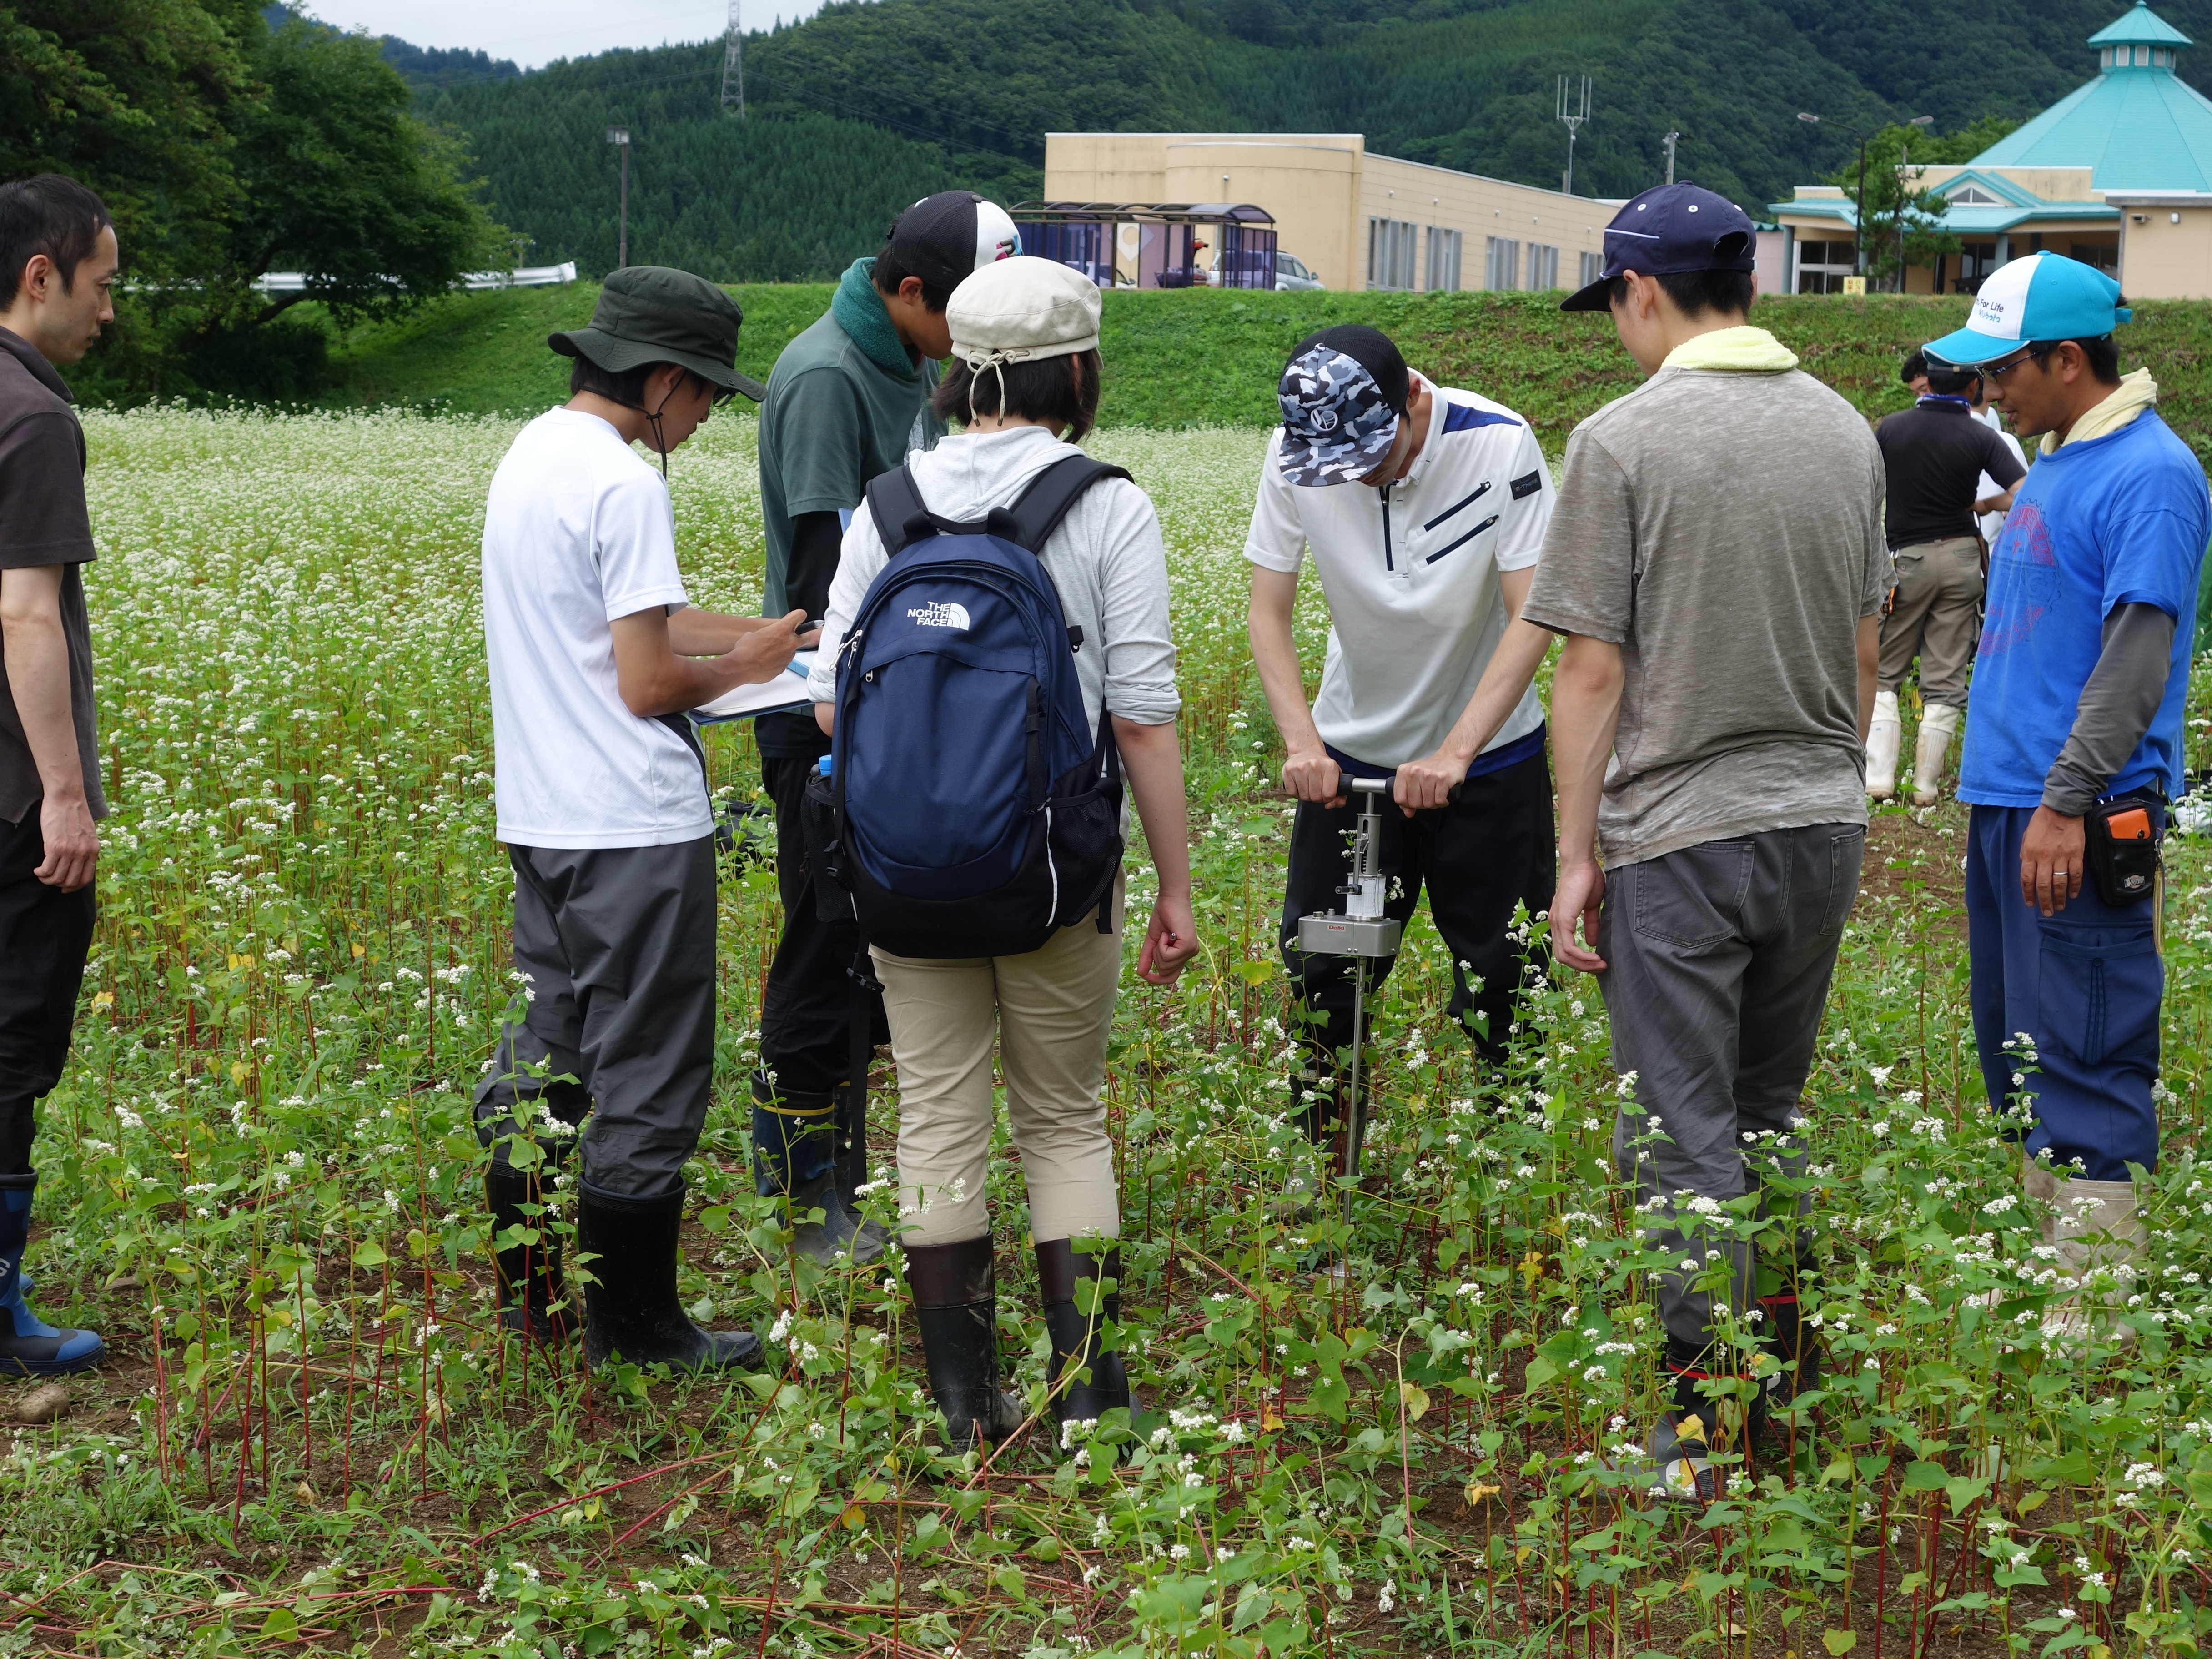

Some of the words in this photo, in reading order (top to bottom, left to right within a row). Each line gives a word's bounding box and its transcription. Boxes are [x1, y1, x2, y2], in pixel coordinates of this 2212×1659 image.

[1980, 299, 1989, 308] For
[1991, 302, 2004, 312] Life
[927, 601, 950, 612] THE
[907, 609, 949, 618] NORTH
[916, 618, 947, 626] FACE
